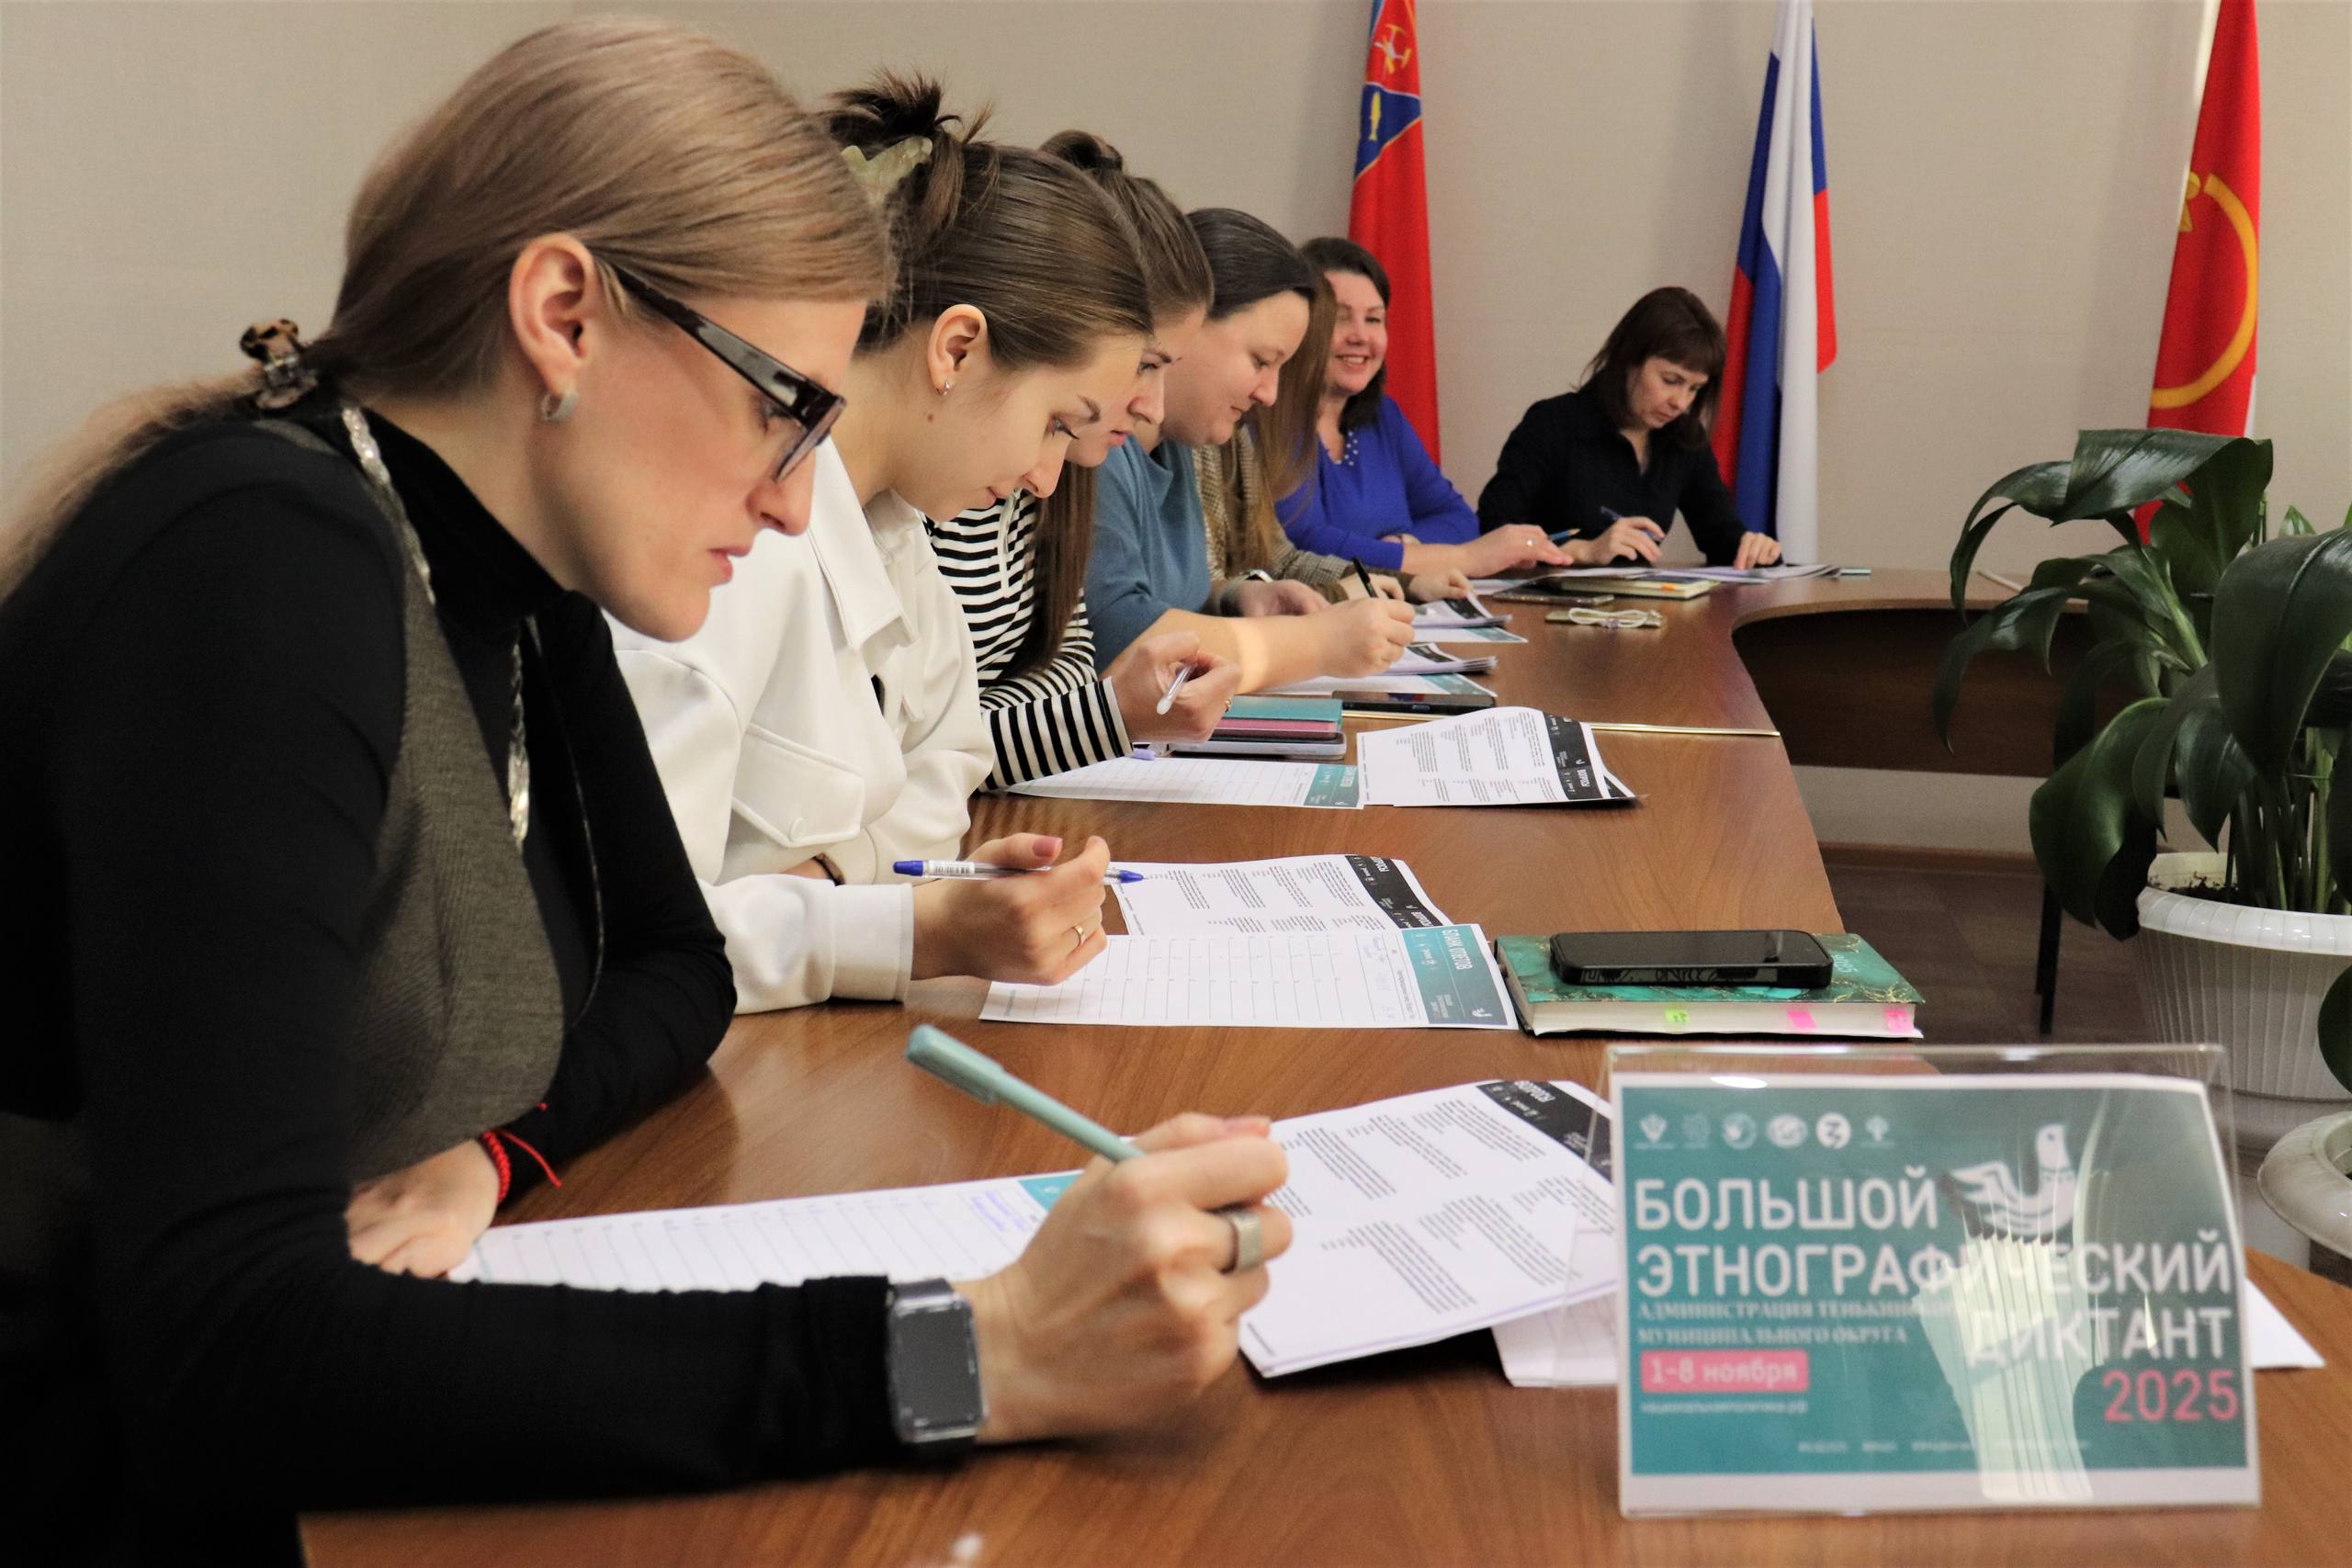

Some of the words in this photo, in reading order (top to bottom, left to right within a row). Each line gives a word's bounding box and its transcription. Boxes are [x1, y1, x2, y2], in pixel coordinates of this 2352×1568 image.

[1635, 1165, 1938, 1230] БОЛЬШОЙ
[1832, 1325, 1907, 1344] ОКРУГА
[1966, 1307, 2232, 1369] ДИКТАНТ
[1650, 1358, 1696, 1384] 1-8
[1702, 1359, 1799, 1389] ноября
[2102, 1369, 2239, 1423] 2025
